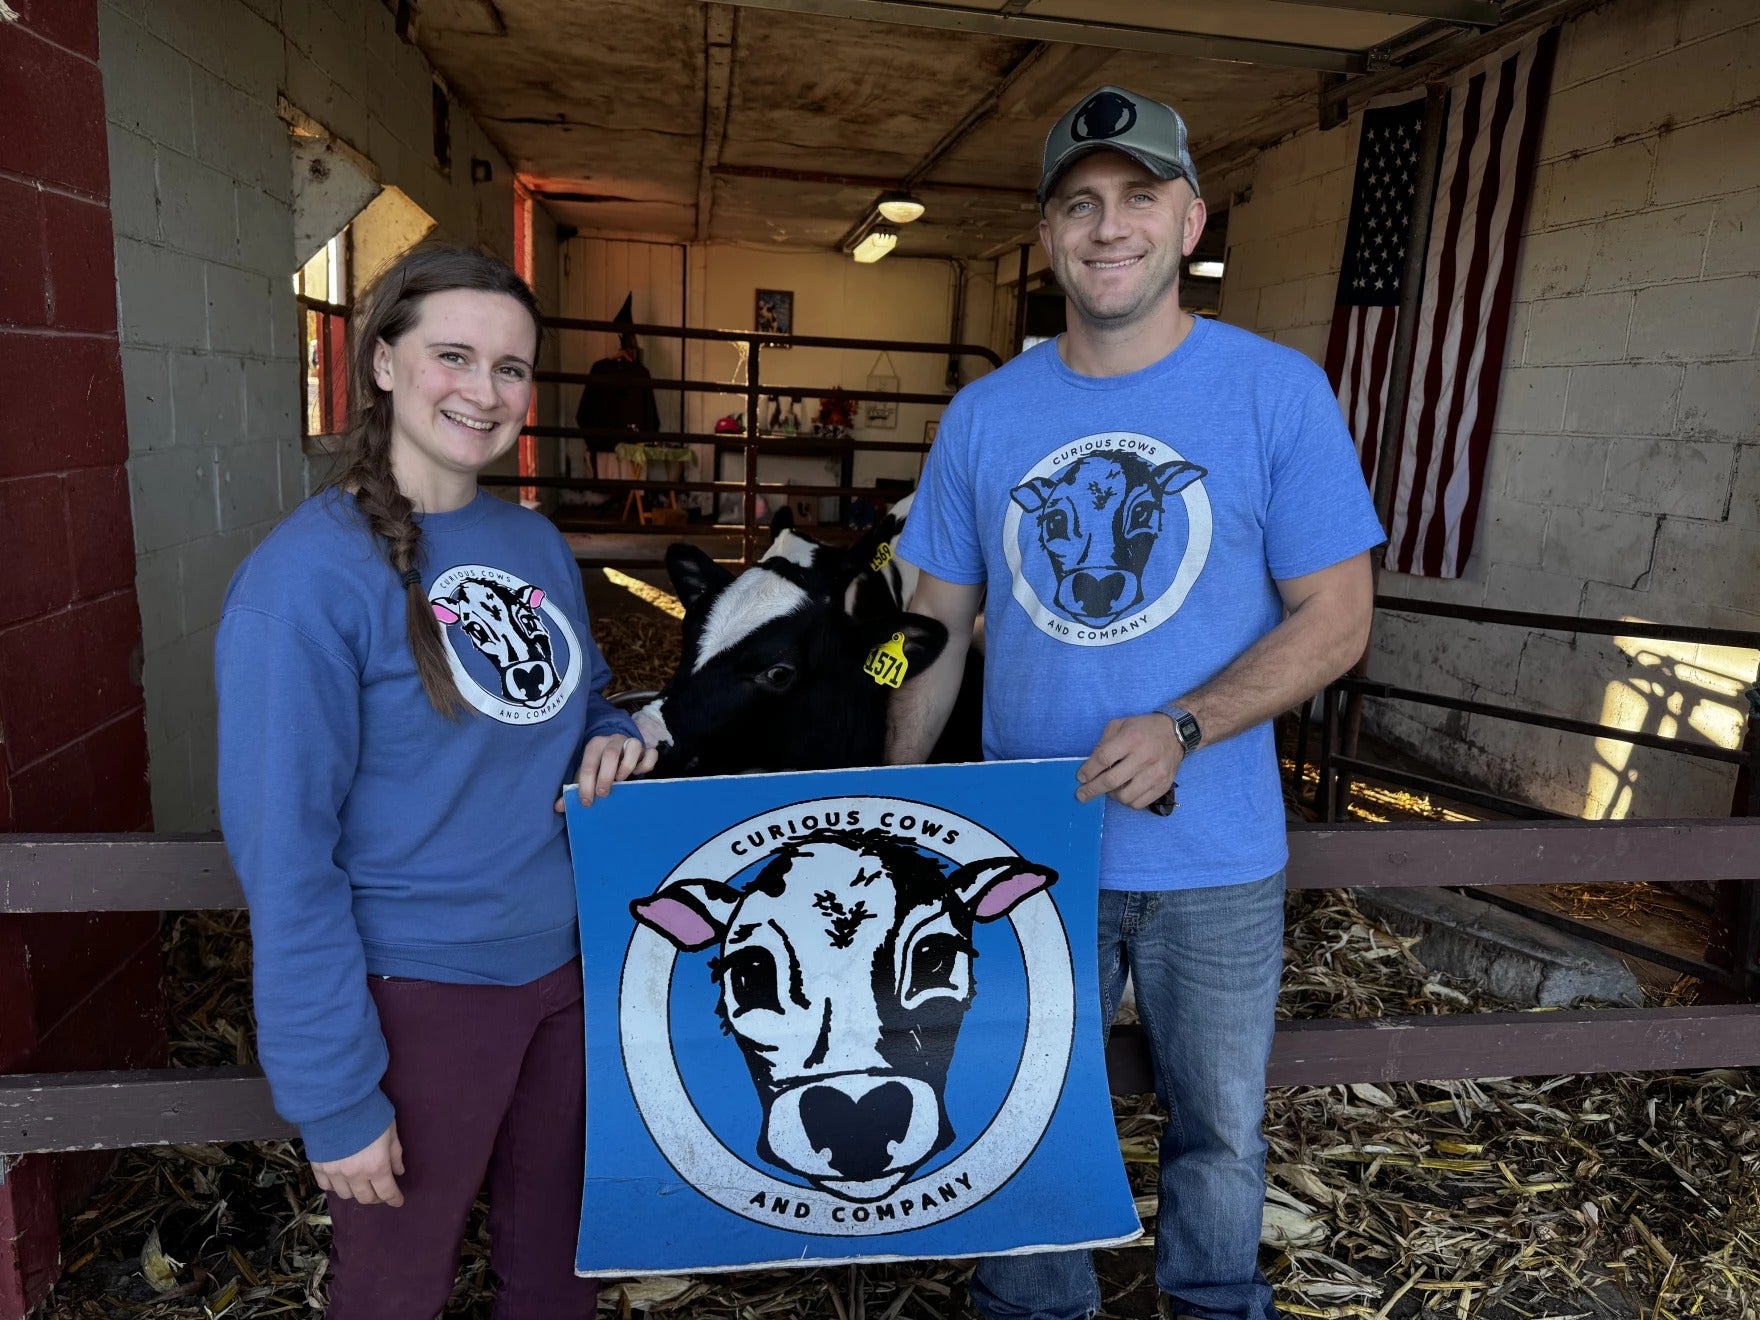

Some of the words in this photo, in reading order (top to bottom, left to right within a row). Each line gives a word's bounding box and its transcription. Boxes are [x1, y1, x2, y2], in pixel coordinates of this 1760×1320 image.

[1053, 439, 1112, 465] CURIOUS
[1118, 439, 1157, 455] COWS
[872, 544, 892, 570] 1569
[440, 569, 476, 589] CURIOUS
[481, 570, 511, 583] COWS
[1047, 619, 1070, 636] AND
[1077, 614, 1149, 640] COMPANY
[865, 648, 904, 686] 1571
[499, 709, 520, 719] AND
[526, 692, 565, 719] COMPANY
[731, 810, 860, 856] CURIOUS
[880, 812, 960, 845] COWS
[750, 1191, 811, 1219] AND
[832, 1172, 973, 1222] COMPANY
